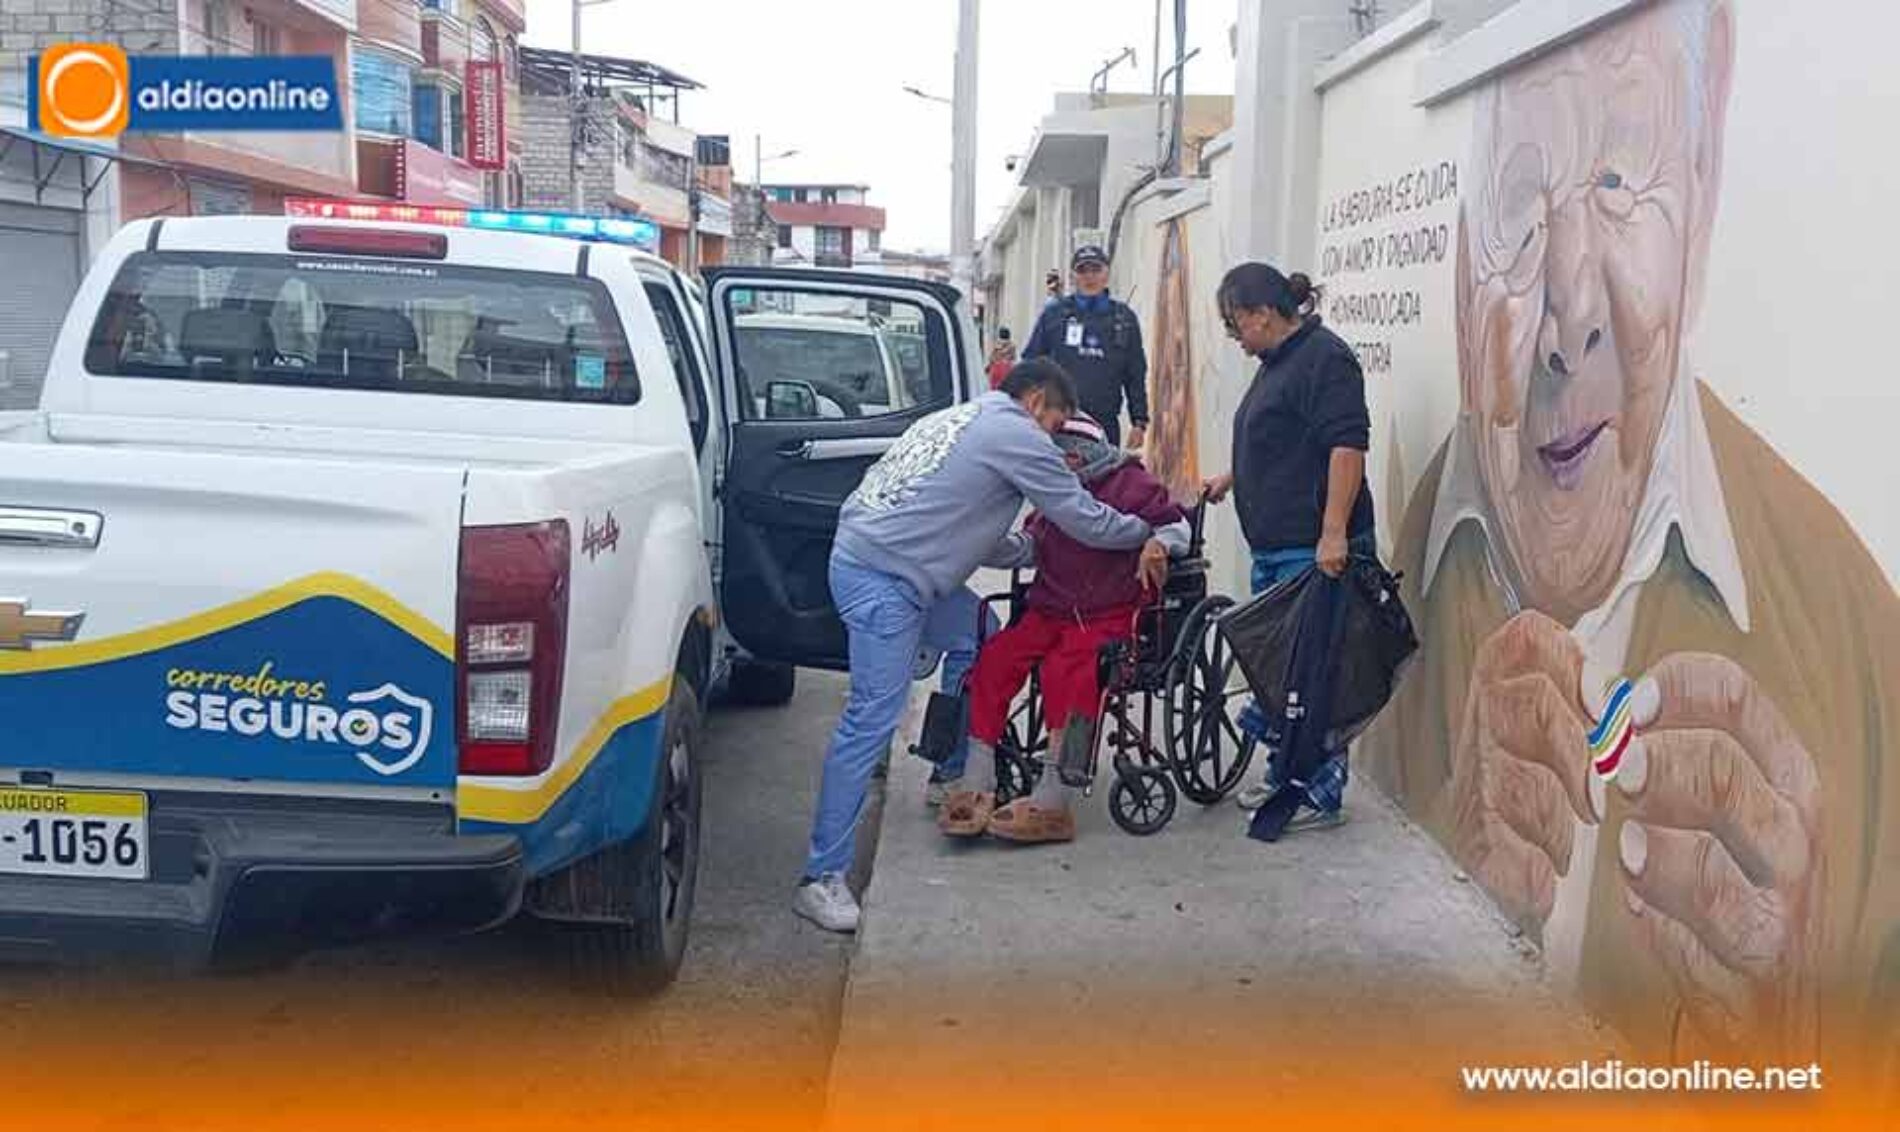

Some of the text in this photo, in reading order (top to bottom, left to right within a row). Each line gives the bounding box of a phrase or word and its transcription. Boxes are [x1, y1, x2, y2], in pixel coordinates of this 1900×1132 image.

[1322, 202, 1336, 232] LA
[1395, 172, 1414, 213] SE
[1414, 160, 1458, 208] CUIDA
[1322, 223, 1449, 277] CON AMOR Y DIGNIDAD
[1388, 290, 1422, 326] CADA
[166, 660, 326, 700] corredores
[166, 690, 413, 750] SEGUROS
[0, 793, 66, 811] UADOR
